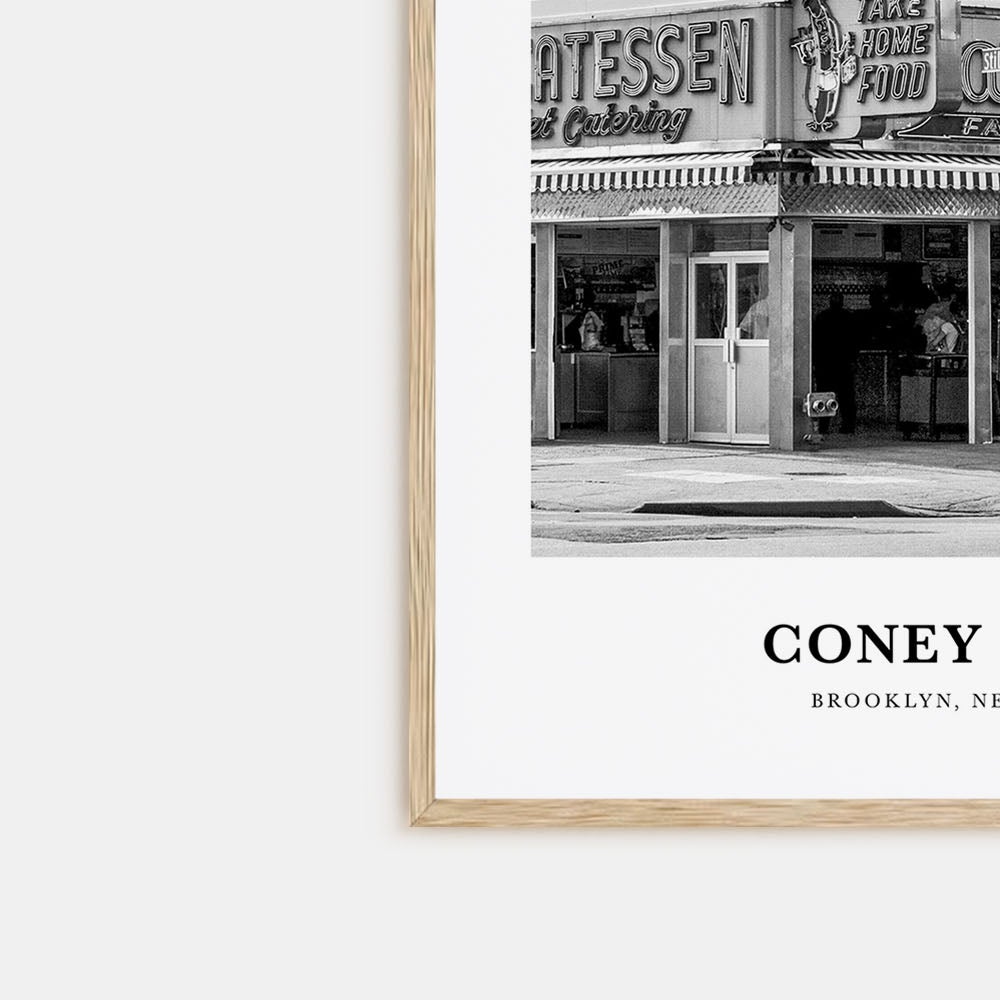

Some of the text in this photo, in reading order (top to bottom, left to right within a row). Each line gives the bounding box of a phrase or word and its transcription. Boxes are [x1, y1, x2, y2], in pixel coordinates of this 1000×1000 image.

[858, 23, 934, 57] HOME
[857, 62, 930, 103] FOOD
[563, 103, 692, 146] Catering
[763, 623, 982, 664] CONEY
[811, 692, 960, 711] BROOKLYN,
